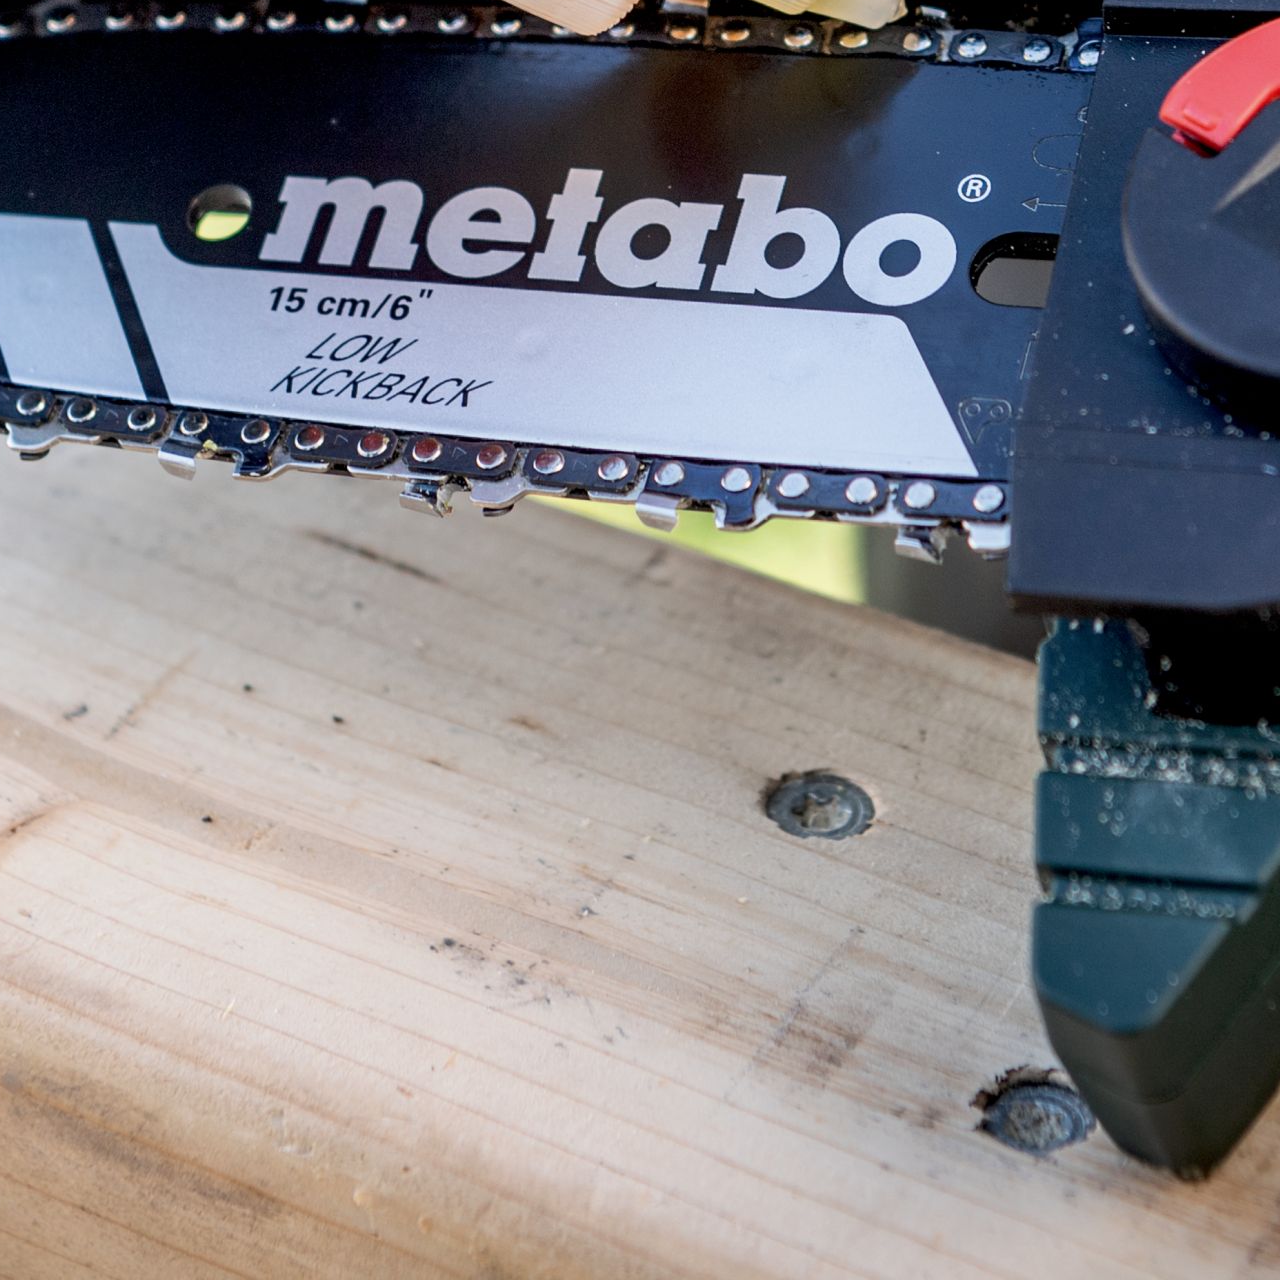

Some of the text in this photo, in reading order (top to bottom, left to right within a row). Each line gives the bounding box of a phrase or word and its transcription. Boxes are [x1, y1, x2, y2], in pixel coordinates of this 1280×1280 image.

[259, 168, 957, 306] metabo
[269, 286, 308, 313] 15
[305, 332, 418, 364] LOW
[270, 365, 493, 407] KICKBACK
